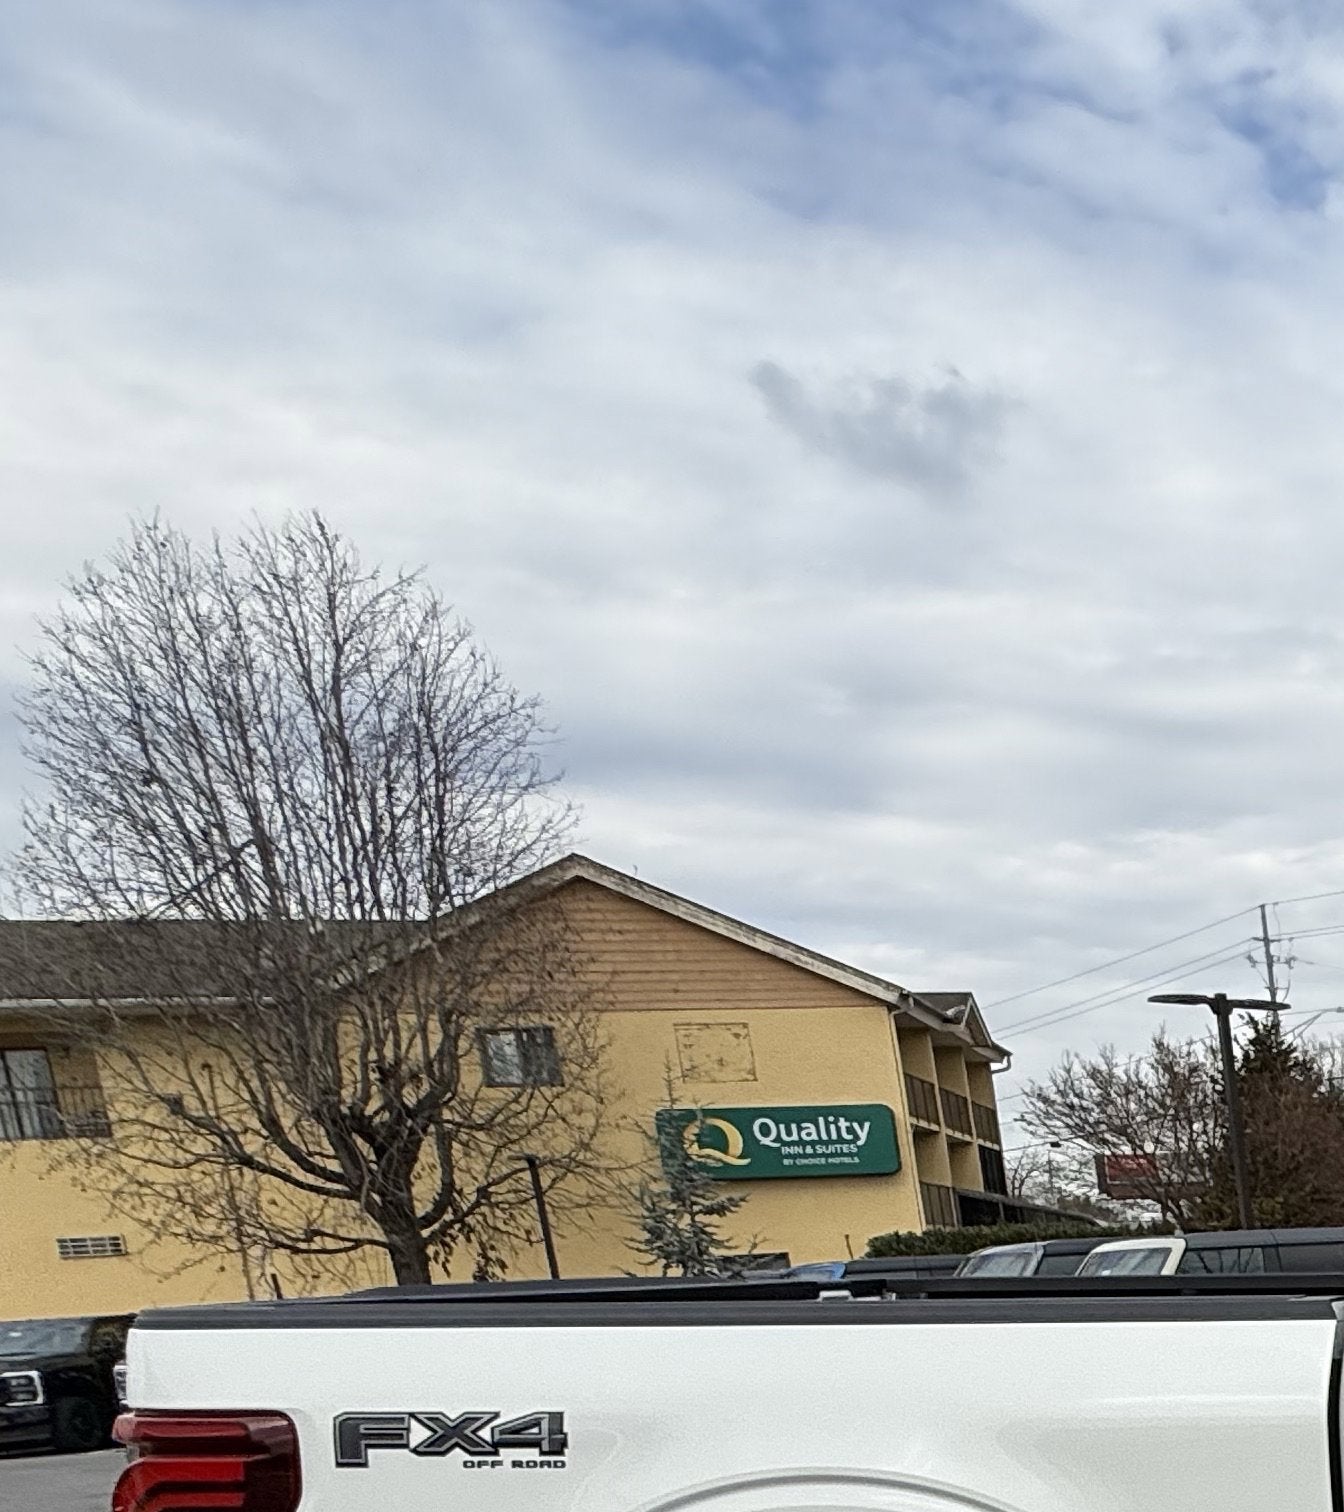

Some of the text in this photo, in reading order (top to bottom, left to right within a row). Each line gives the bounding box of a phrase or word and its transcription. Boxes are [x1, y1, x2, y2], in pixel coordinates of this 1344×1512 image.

[752, 1115, 870, 1147] Quality
[781, 1144, 859, 1155] INN & SUITES
[827, 1156, 860, 1164] HOTELS
[333, 1411, 568, 1468] FX4
[463, 1459, 567, 1469] OFF ROAD
